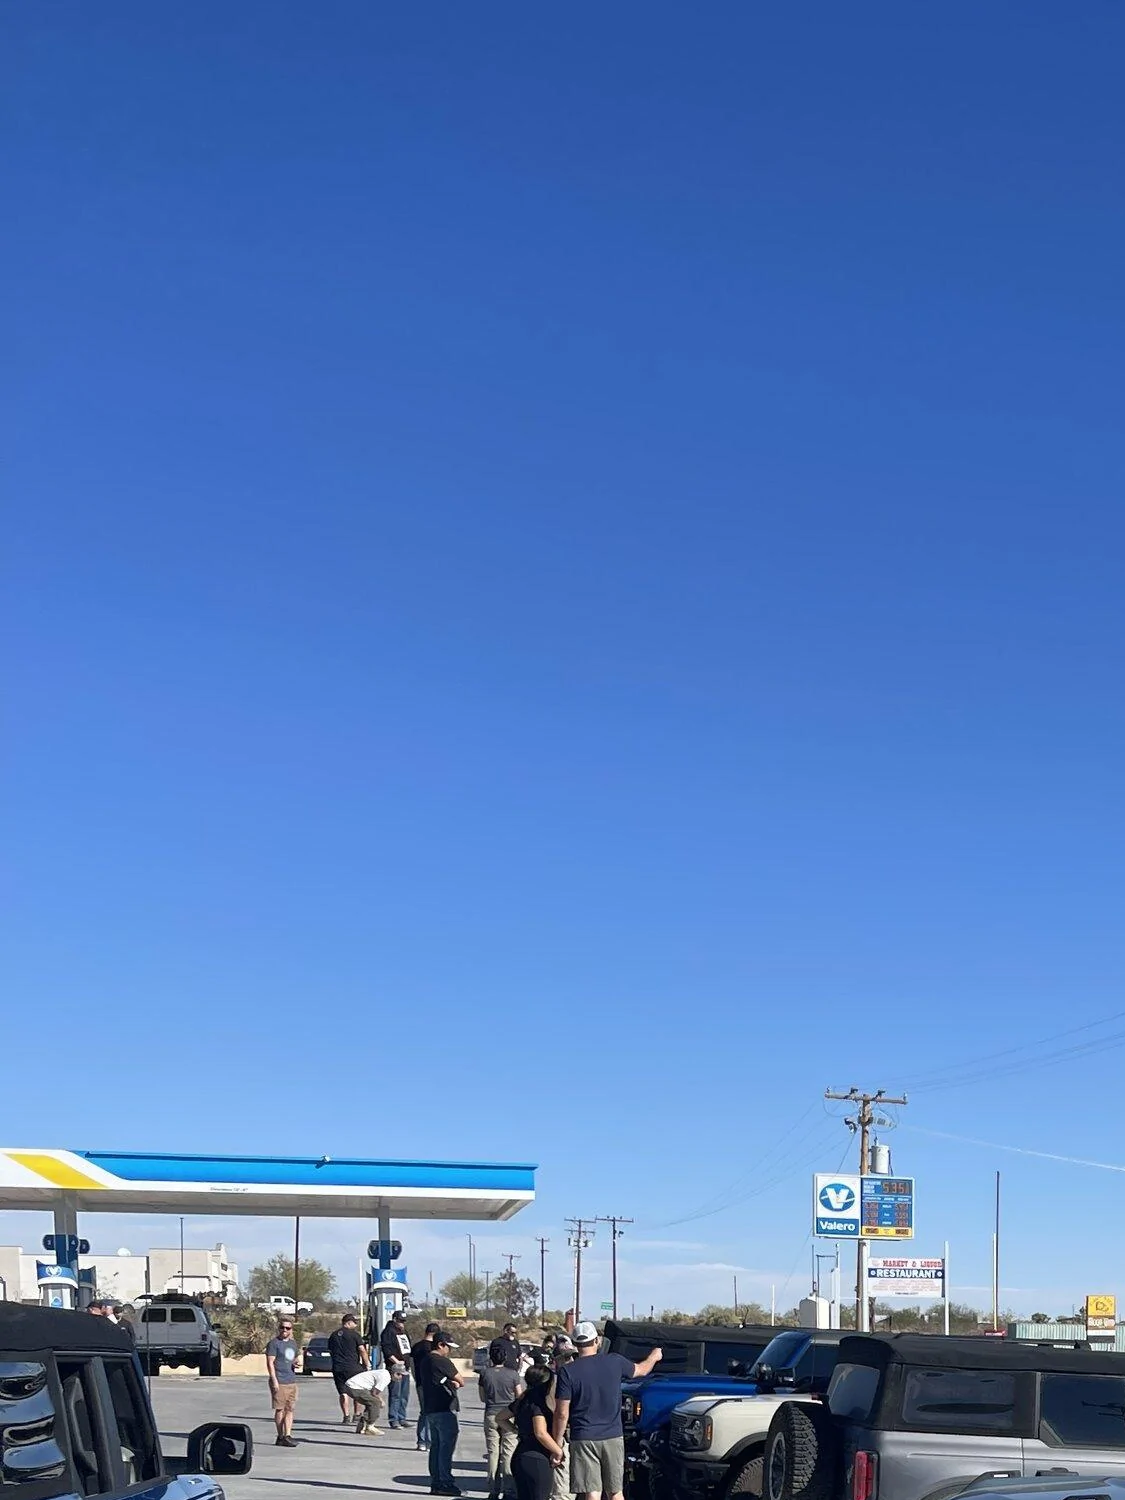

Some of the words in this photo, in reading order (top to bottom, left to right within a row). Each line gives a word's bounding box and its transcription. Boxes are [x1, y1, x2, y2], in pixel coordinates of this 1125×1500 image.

[819, 1219, 856, 1232] Valero
[882, 1260, 909, 1268] MARKET
[876, 1269, 937, 1279] RESTAURANT
